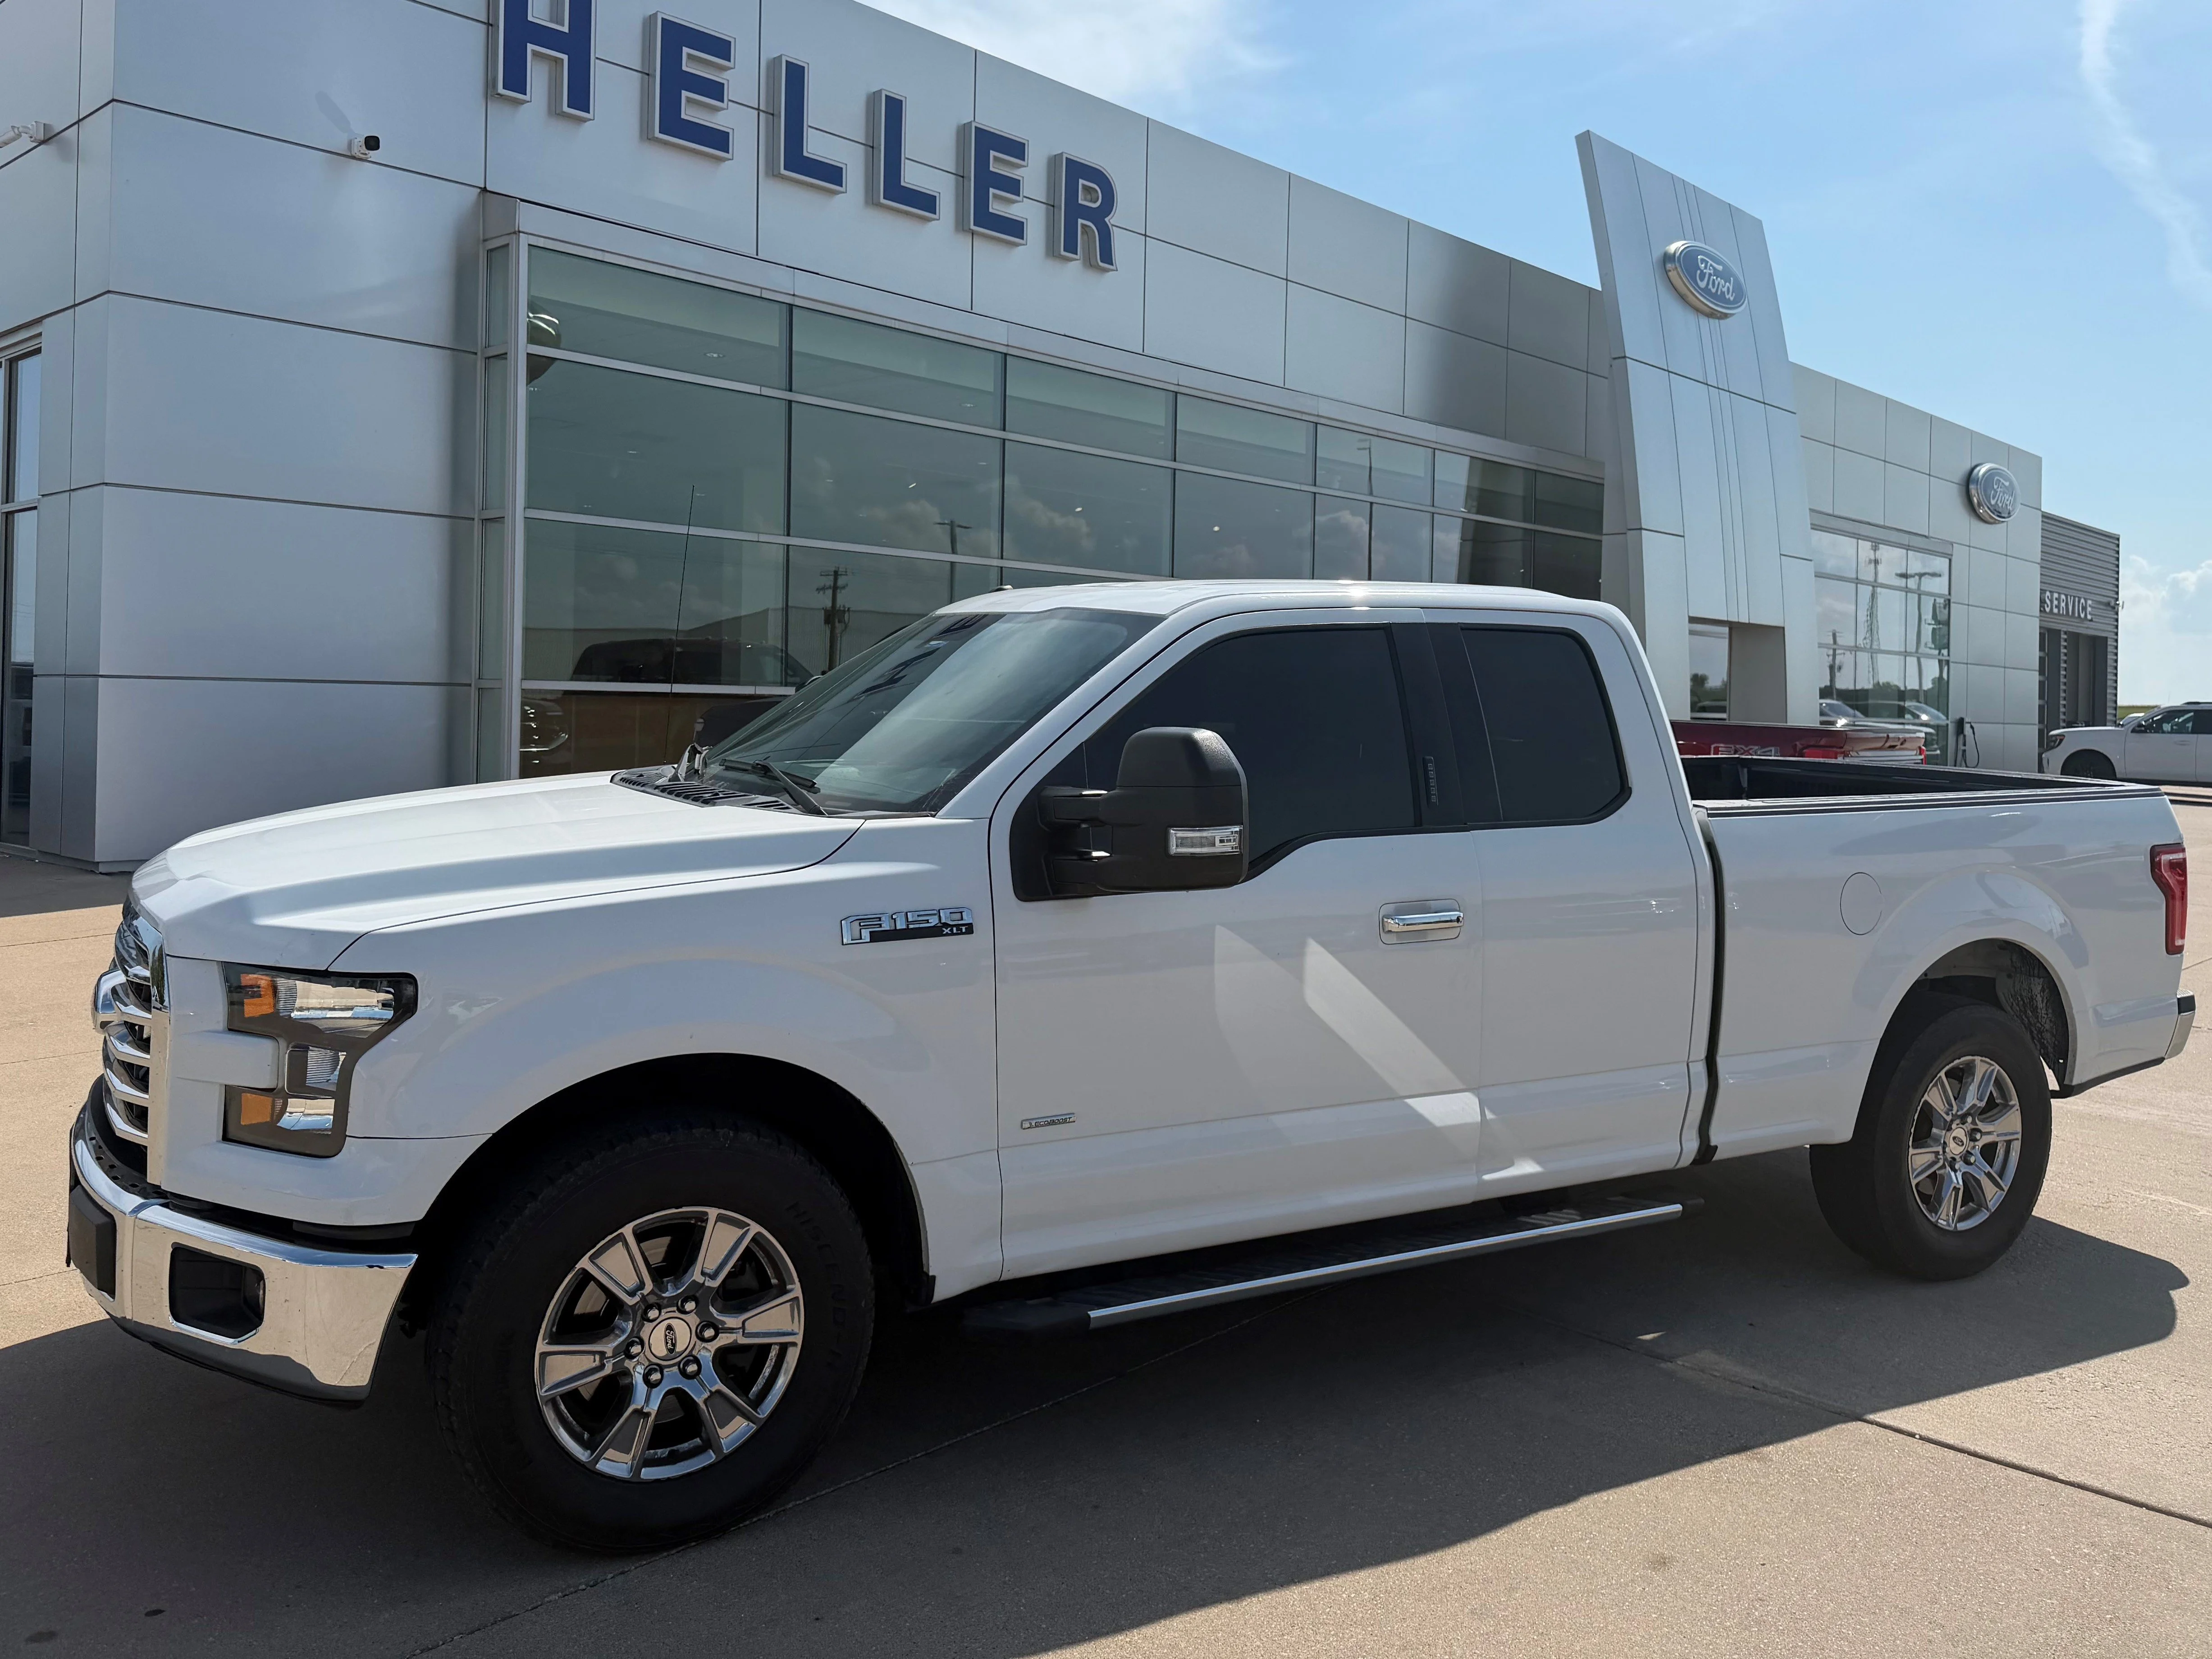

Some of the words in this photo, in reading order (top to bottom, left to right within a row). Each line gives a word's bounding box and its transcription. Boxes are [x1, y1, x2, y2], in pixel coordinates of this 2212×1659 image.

[491, 0, 1118, 272] HELLER
[1696, 255, 1735, 301] Ford
[1990, 476, 2015, 511] Ford
[2045, 590, 2093, 620] SERVICE
[941, 927, 968, 935] XLT
[666, 1330, 675, 1350] Ford
